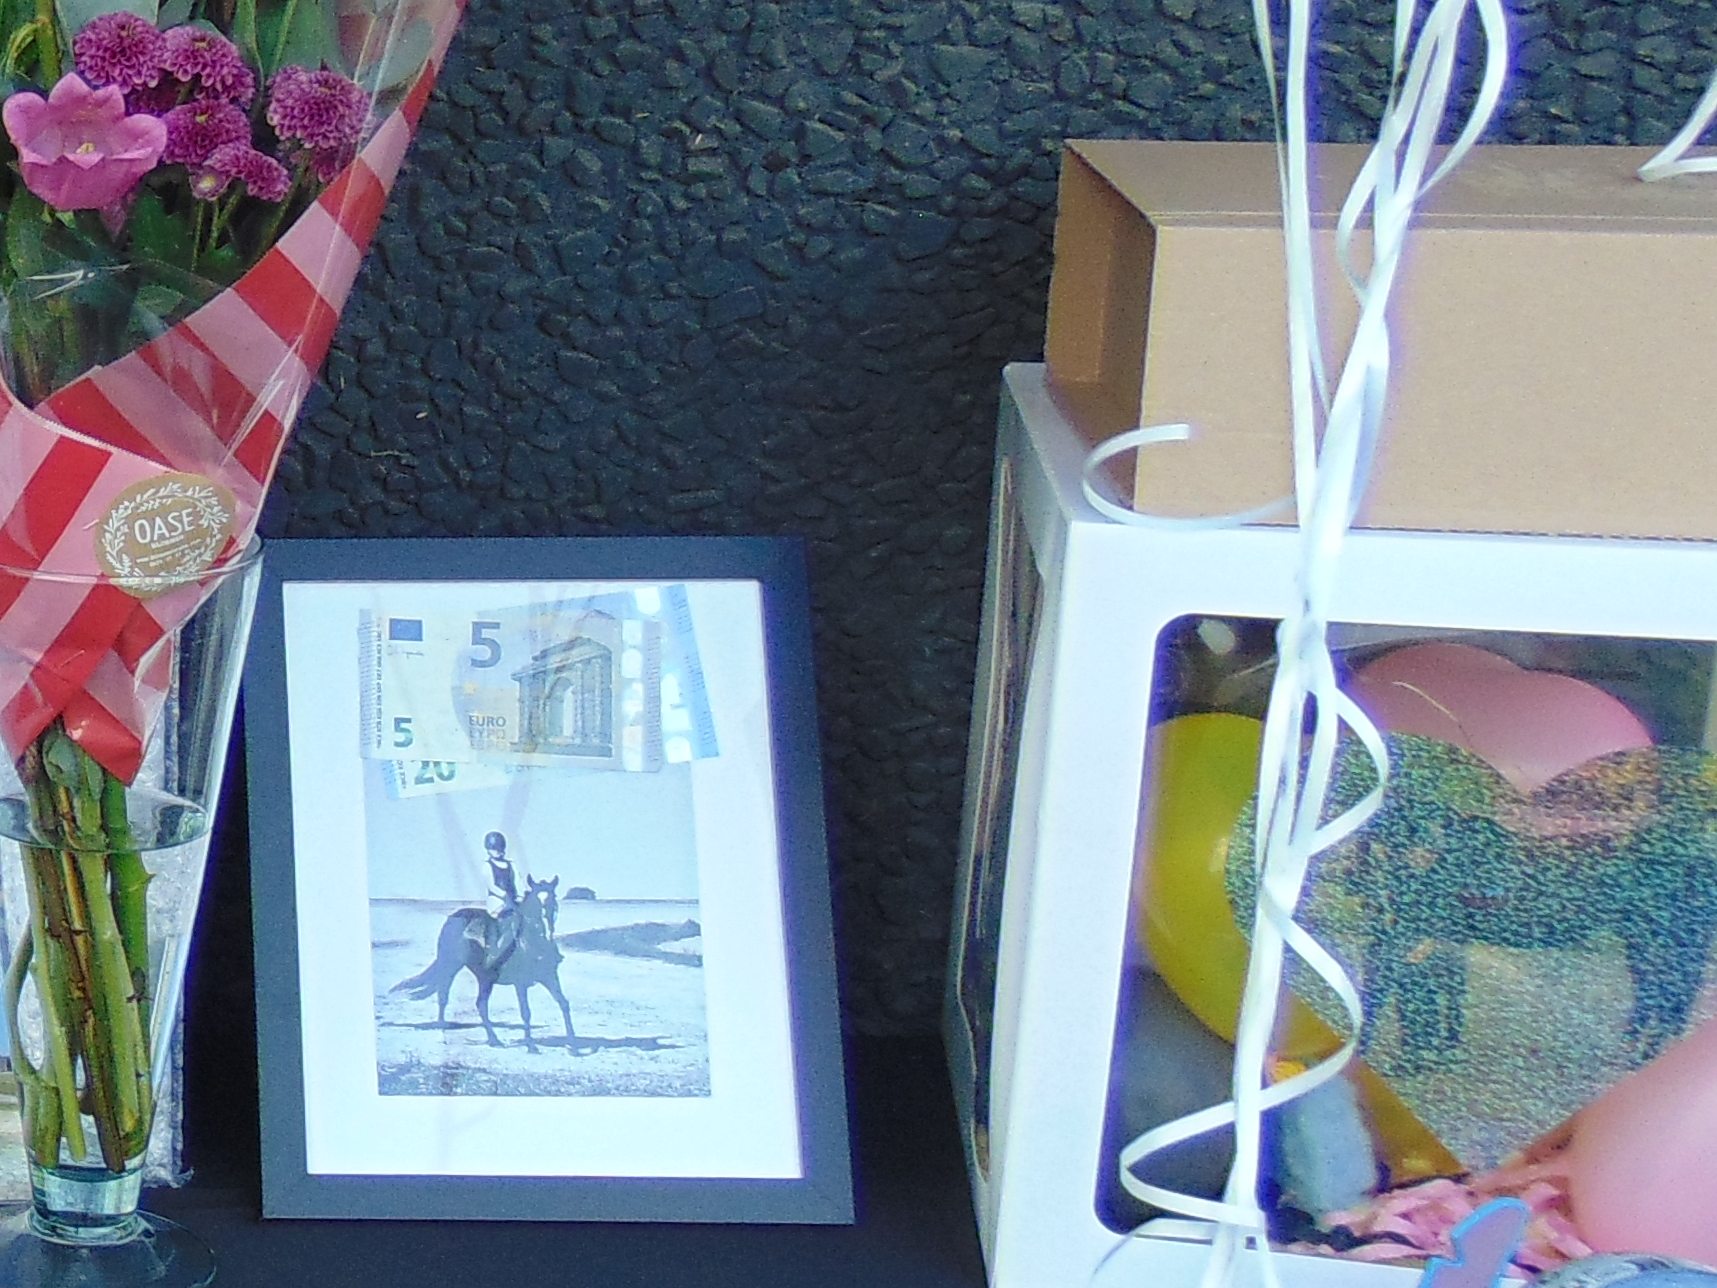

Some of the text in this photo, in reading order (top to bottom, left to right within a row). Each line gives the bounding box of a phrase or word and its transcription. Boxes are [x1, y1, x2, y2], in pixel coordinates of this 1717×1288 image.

[134, 507, 196, 544] OASE
[470, 621, 503, 669] 5
[393, 716, 414, 749] 5
[468, 715, 507, 728] EURO
[414, 761, 457, 786] 20
